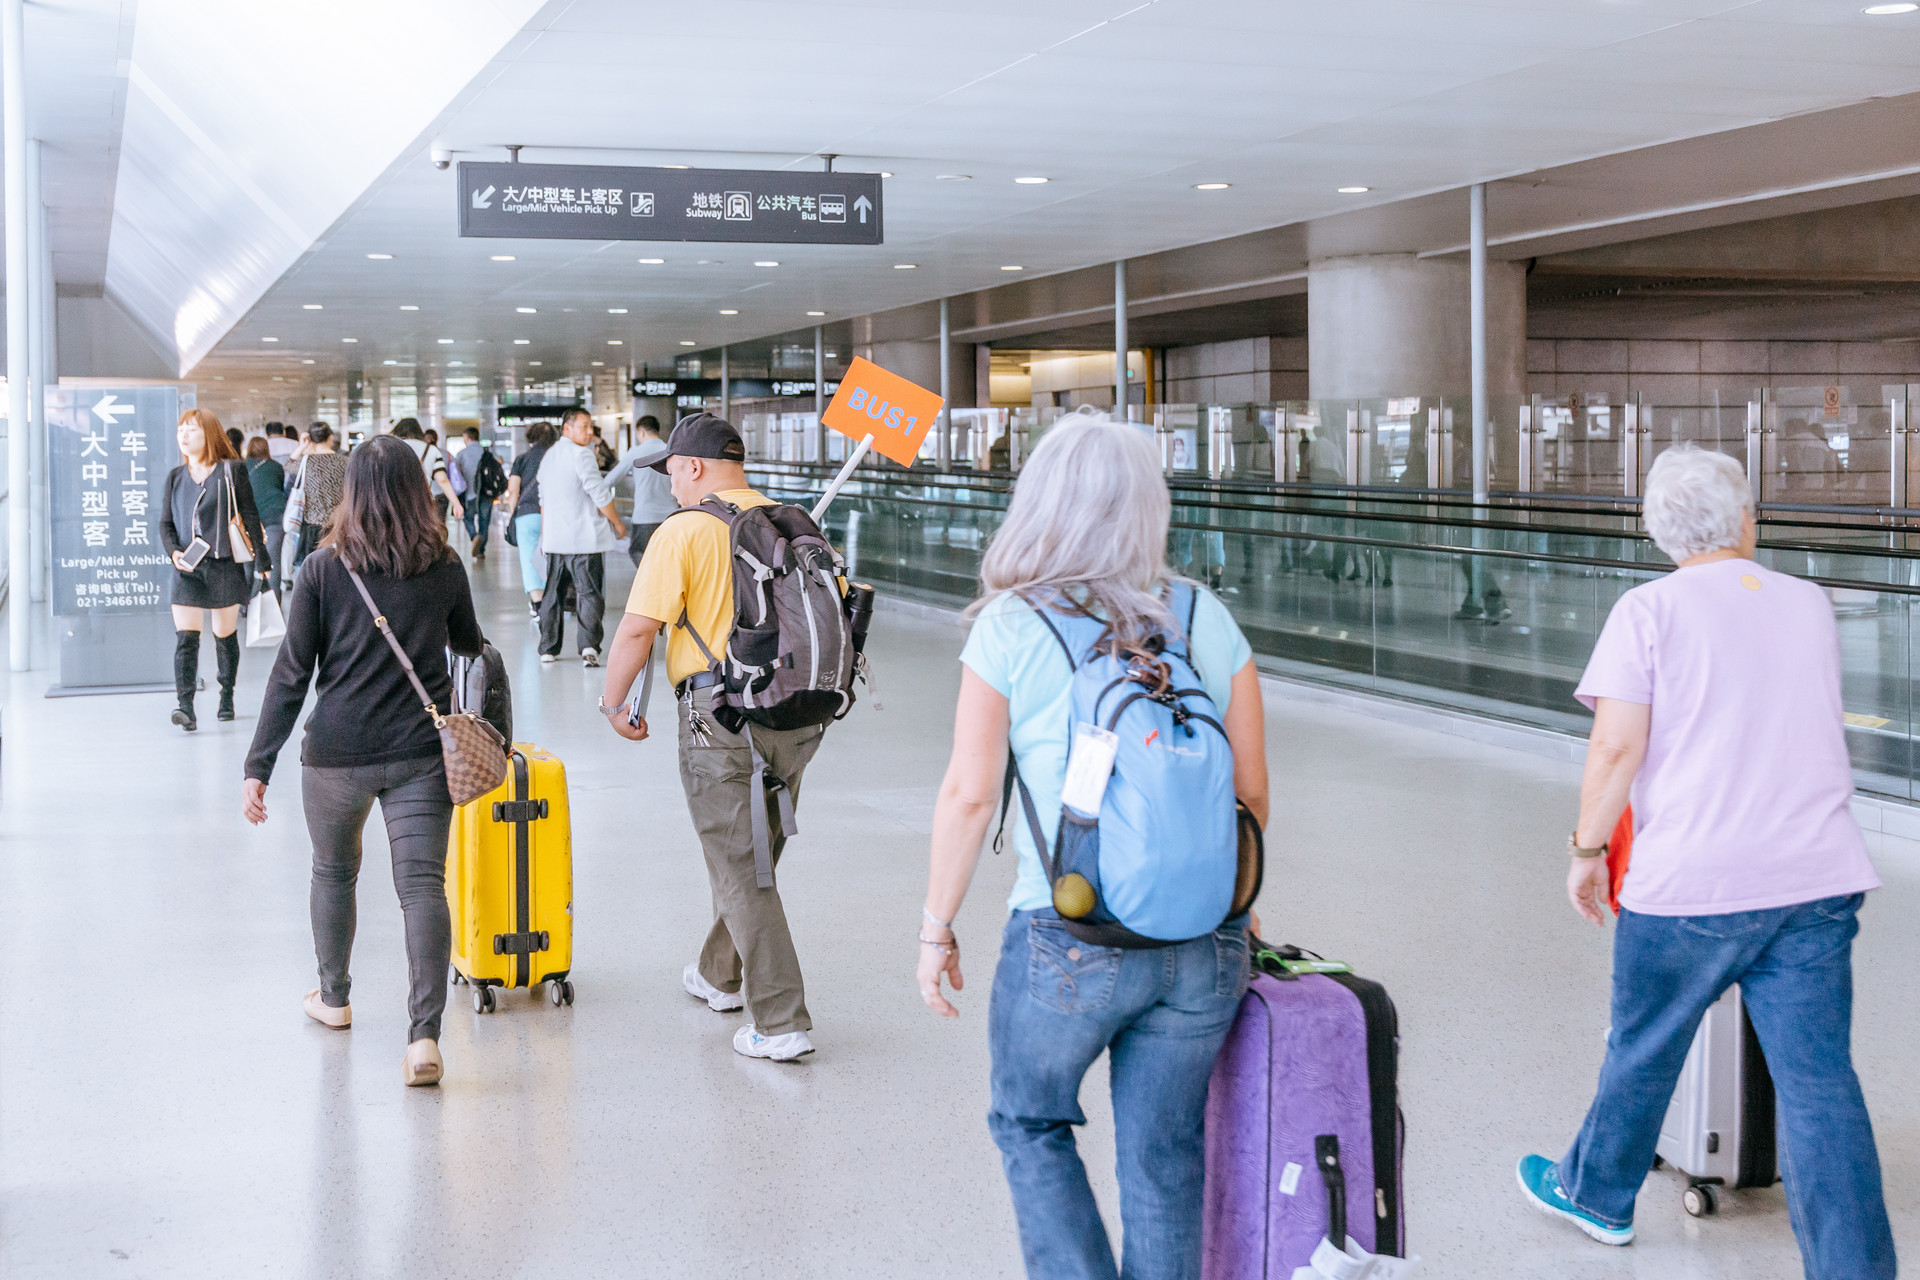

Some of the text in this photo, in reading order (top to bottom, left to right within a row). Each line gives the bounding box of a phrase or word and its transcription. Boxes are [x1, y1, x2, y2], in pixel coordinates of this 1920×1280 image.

[502, 186, 623, 205] 大/中型车上客区
[692, 192, 723, 209] 地铁
[502, 203, 618, 216] Large/Mid Vehicle Pick Up
[756, 194, 817, 212] 公共汽车
[686, 207, 722, 220] Subway
[801, 211, 817, 220] Bus
[61, 553, 173, 570] Large/Mid Vehicle
[96, 569, 139, 581] Pick up
[76, 595, 160, 608] 021-34661617
